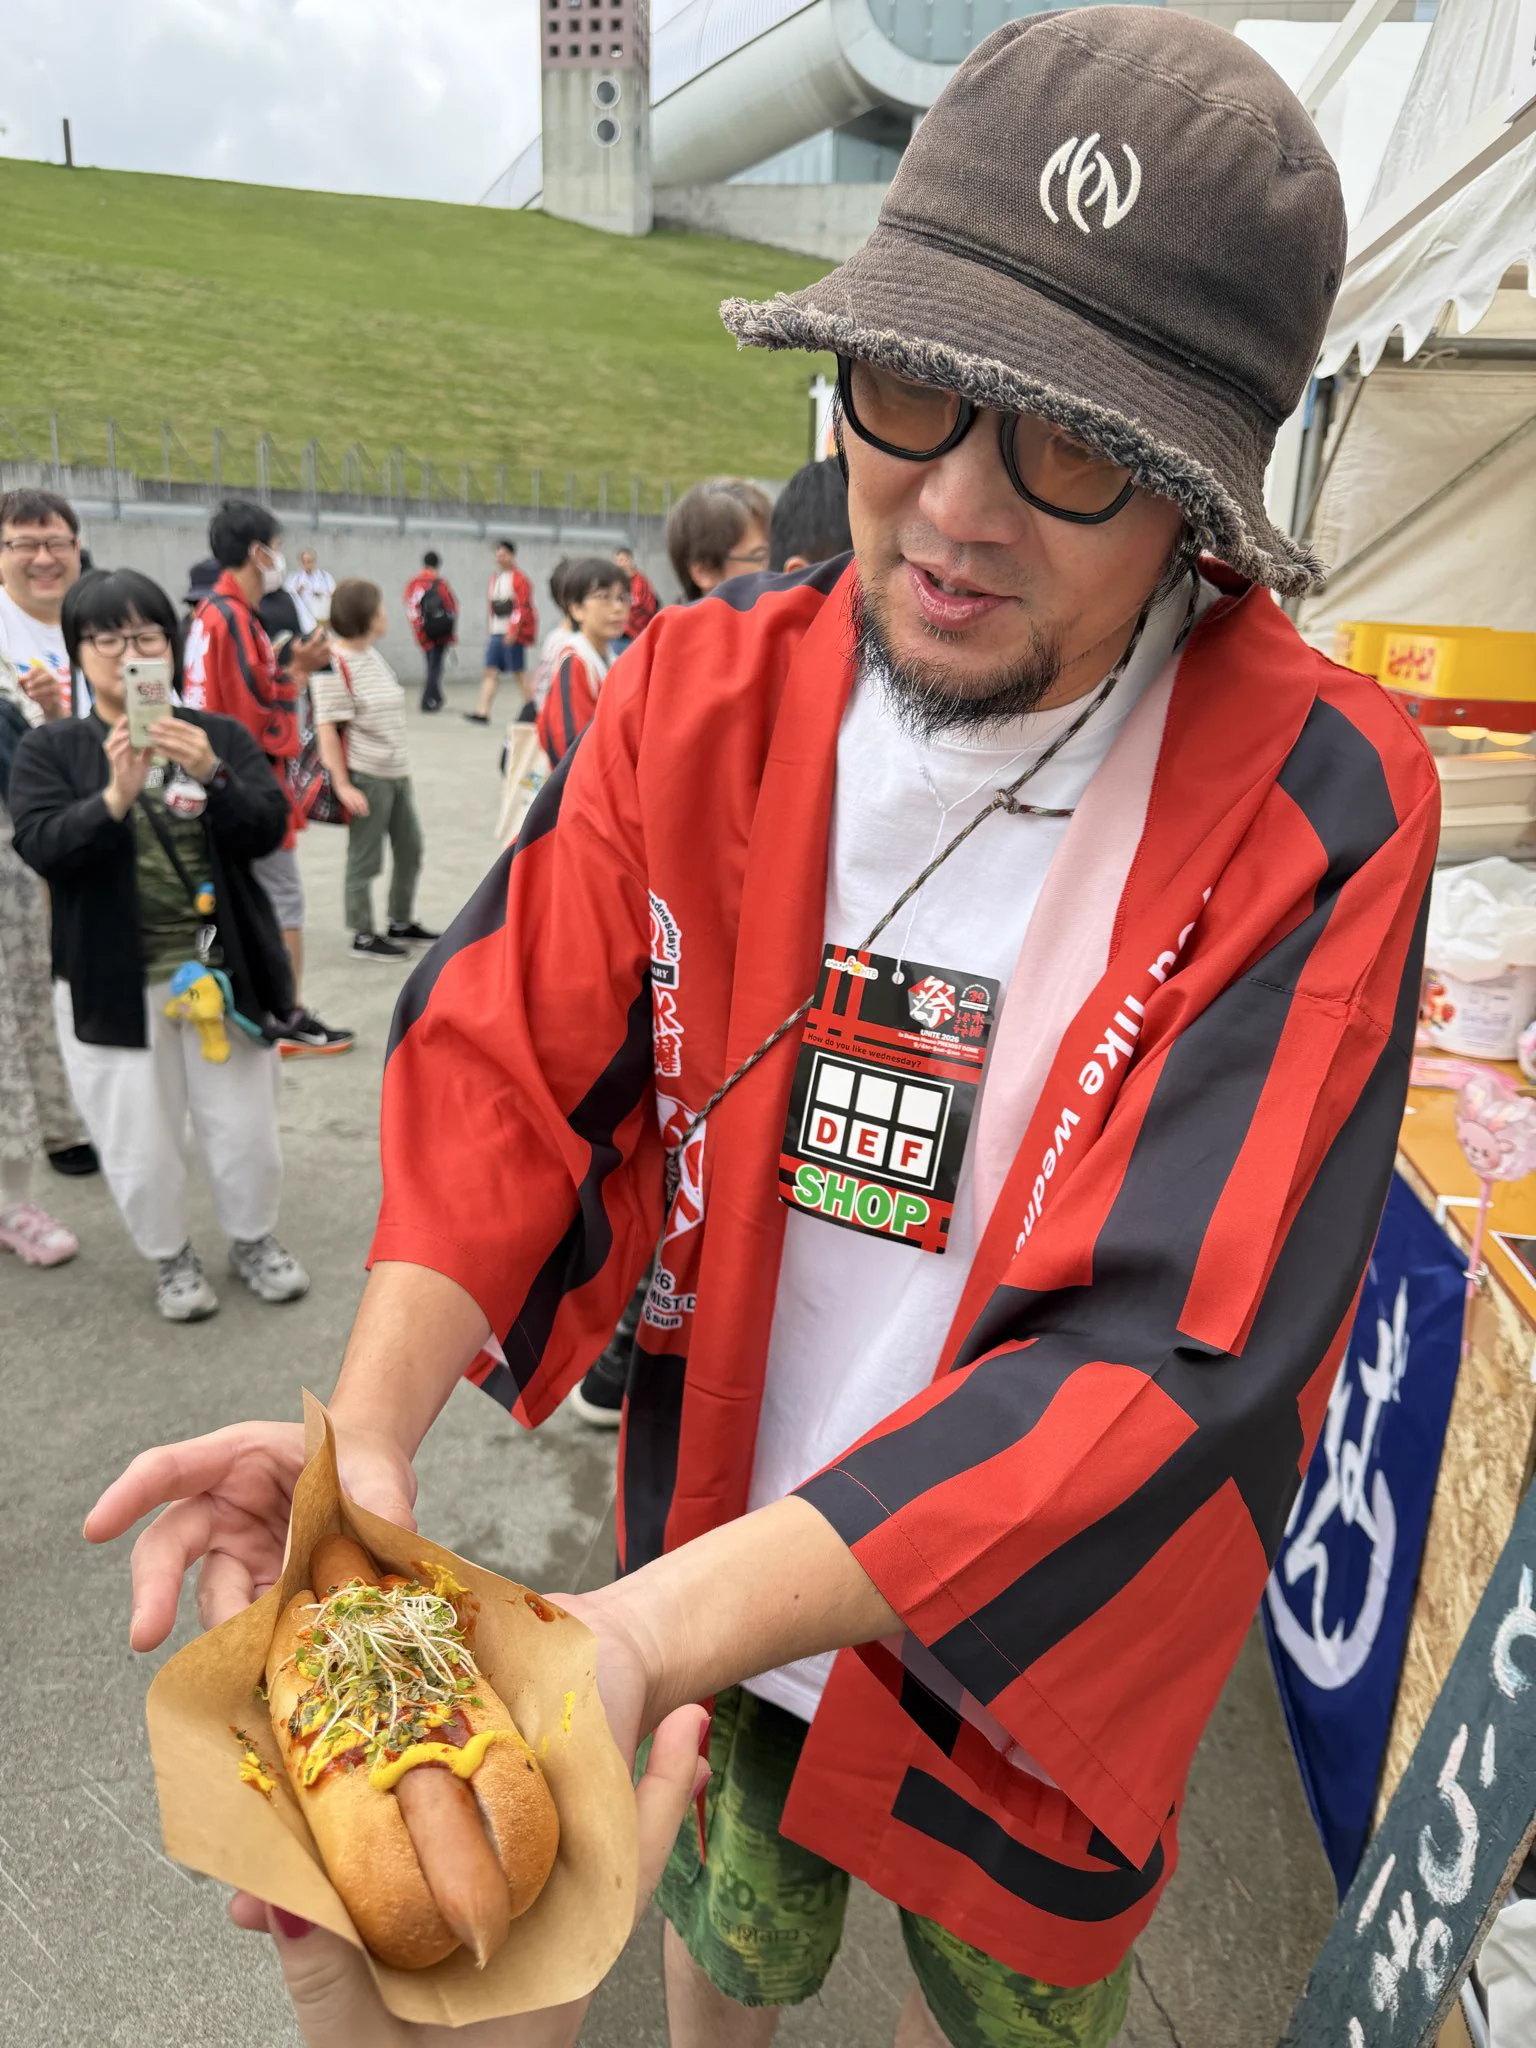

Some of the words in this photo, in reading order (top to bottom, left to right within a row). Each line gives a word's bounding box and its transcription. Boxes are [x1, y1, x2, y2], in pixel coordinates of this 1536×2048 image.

[650, 897, 678, 959] ednesday?
[807, 1032, 823, 1043] How
[825, 1038, 835, 1047] do
[836, 1042, 850, 1052] you
[852, 1044, 867, 1055] like
[868, 1049, 922, 1068] wednesday?
[1078, 994, 1146, 1096] like
[792, 1164, 931, 1237] SHOP
[1012, 1107, 1081, 1261] wedne
